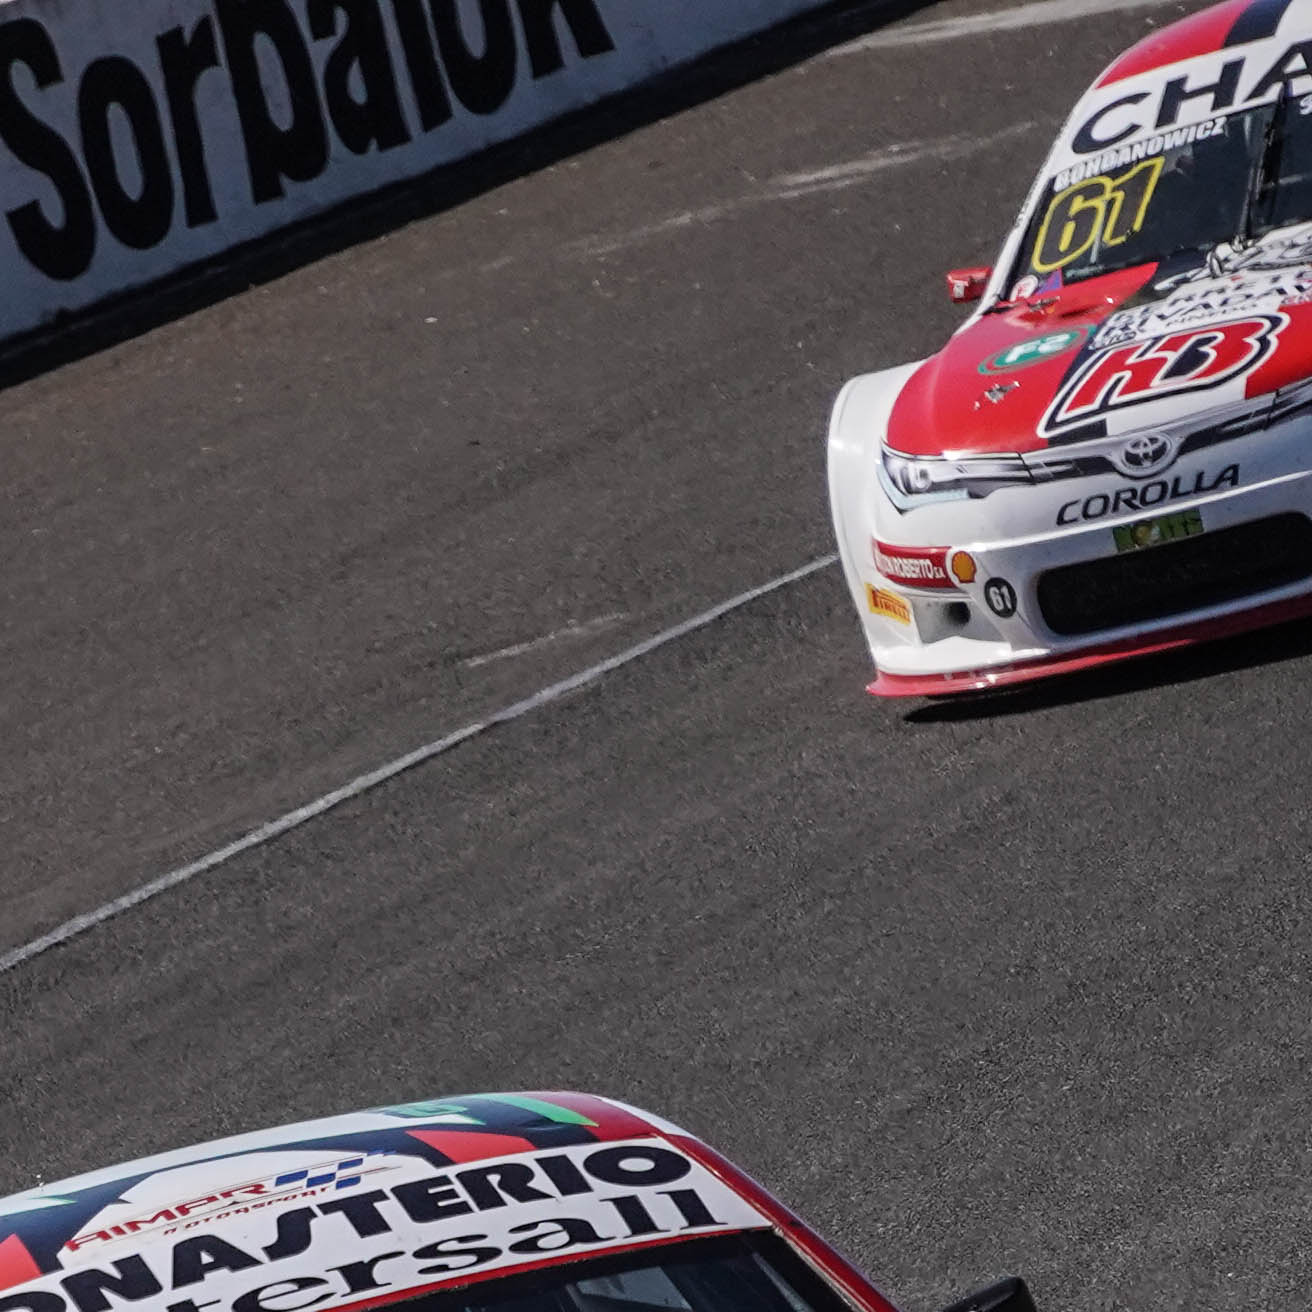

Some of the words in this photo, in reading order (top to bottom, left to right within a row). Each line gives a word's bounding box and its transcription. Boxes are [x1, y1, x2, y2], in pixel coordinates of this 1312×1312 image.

[1031, 156, 1166, 274] 61
[1055, 463, 1241, 526] COROLLA
[872, 589, 911, 626] PIRELLI
[990, 585, 1013, 612] 61
